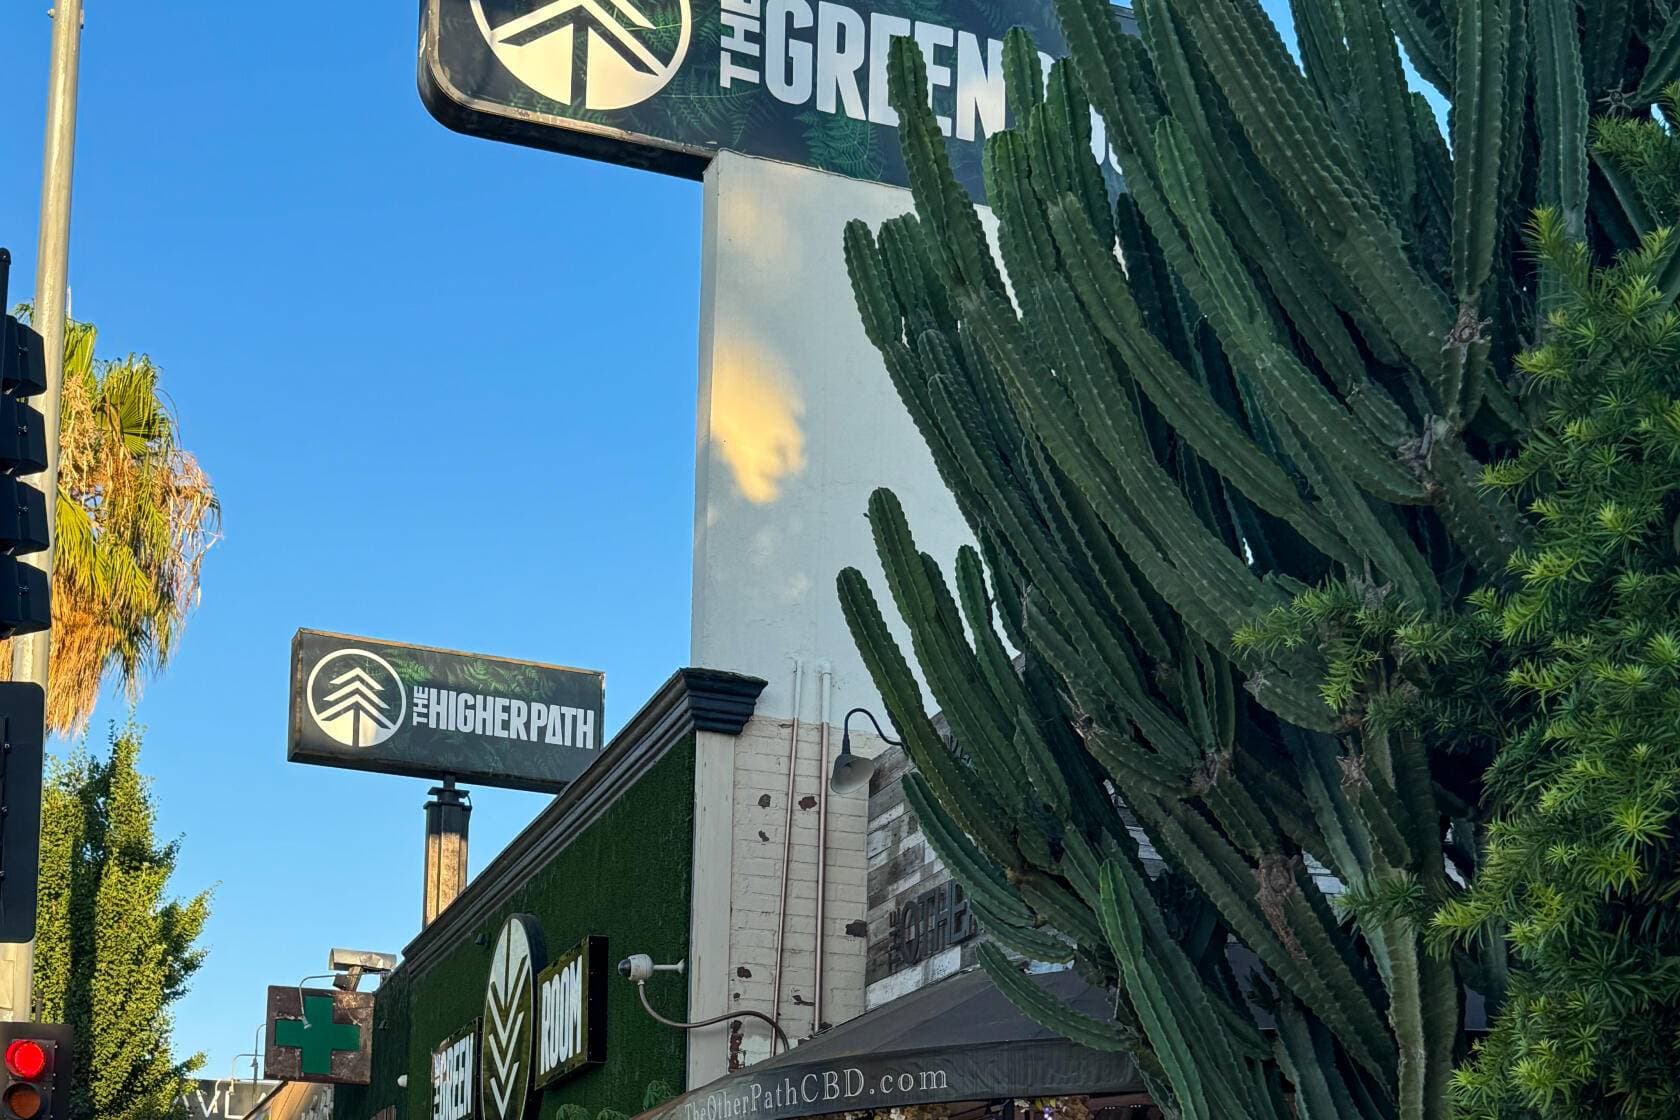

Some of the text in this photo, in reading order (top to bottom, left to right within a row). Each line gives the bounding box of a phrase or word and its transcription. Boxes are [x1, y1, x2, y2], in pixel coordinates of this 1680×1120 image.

[765, 0, 1006, 142] GREEN
[412, 685, 429, 726] THE
[540, 954, 583, 1076] ROOM
